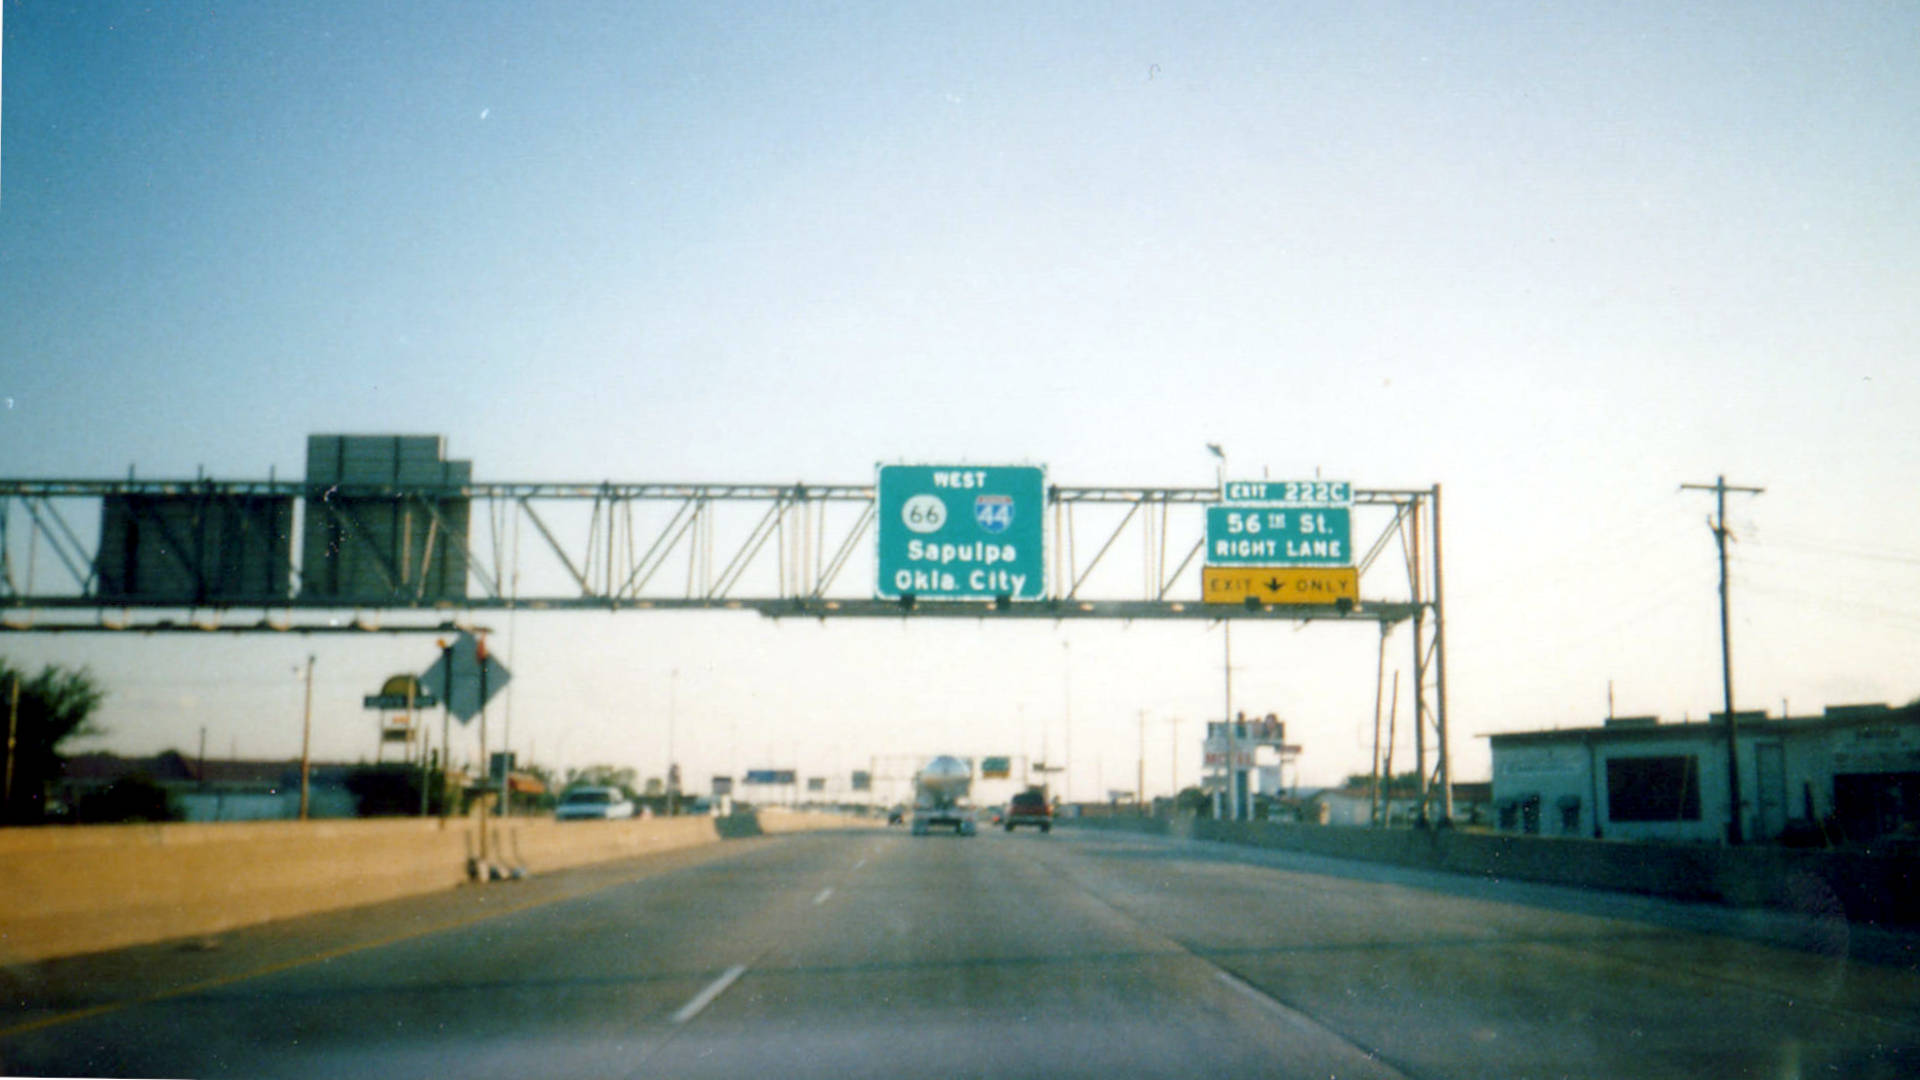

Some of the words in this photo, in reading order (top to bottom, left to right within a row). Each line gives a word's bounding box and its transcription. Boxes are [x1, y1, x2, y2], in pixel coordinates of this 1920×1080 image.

[933, 471, 987, 488] WEST
[1230, 483, 1267, 498] EXIT
[1284, 482, 1344, 501] 222C
[910, 505, 939, 524] 66
[977, 504, 1009, 525] 44
[1300, 513, 1333, 534] St.
[908, 539, 1016, 565] Sapulpa
[1216, 540, 1276, 557] RIGHT
[1286, 540, 1341, 557] LANE
[895, 570, 959, 590] Okla.
[970, 570, 1026, 597] City
[1210, 578, 1252, 593] EXIT
[1296, 579, 1348, 593] ONLY
